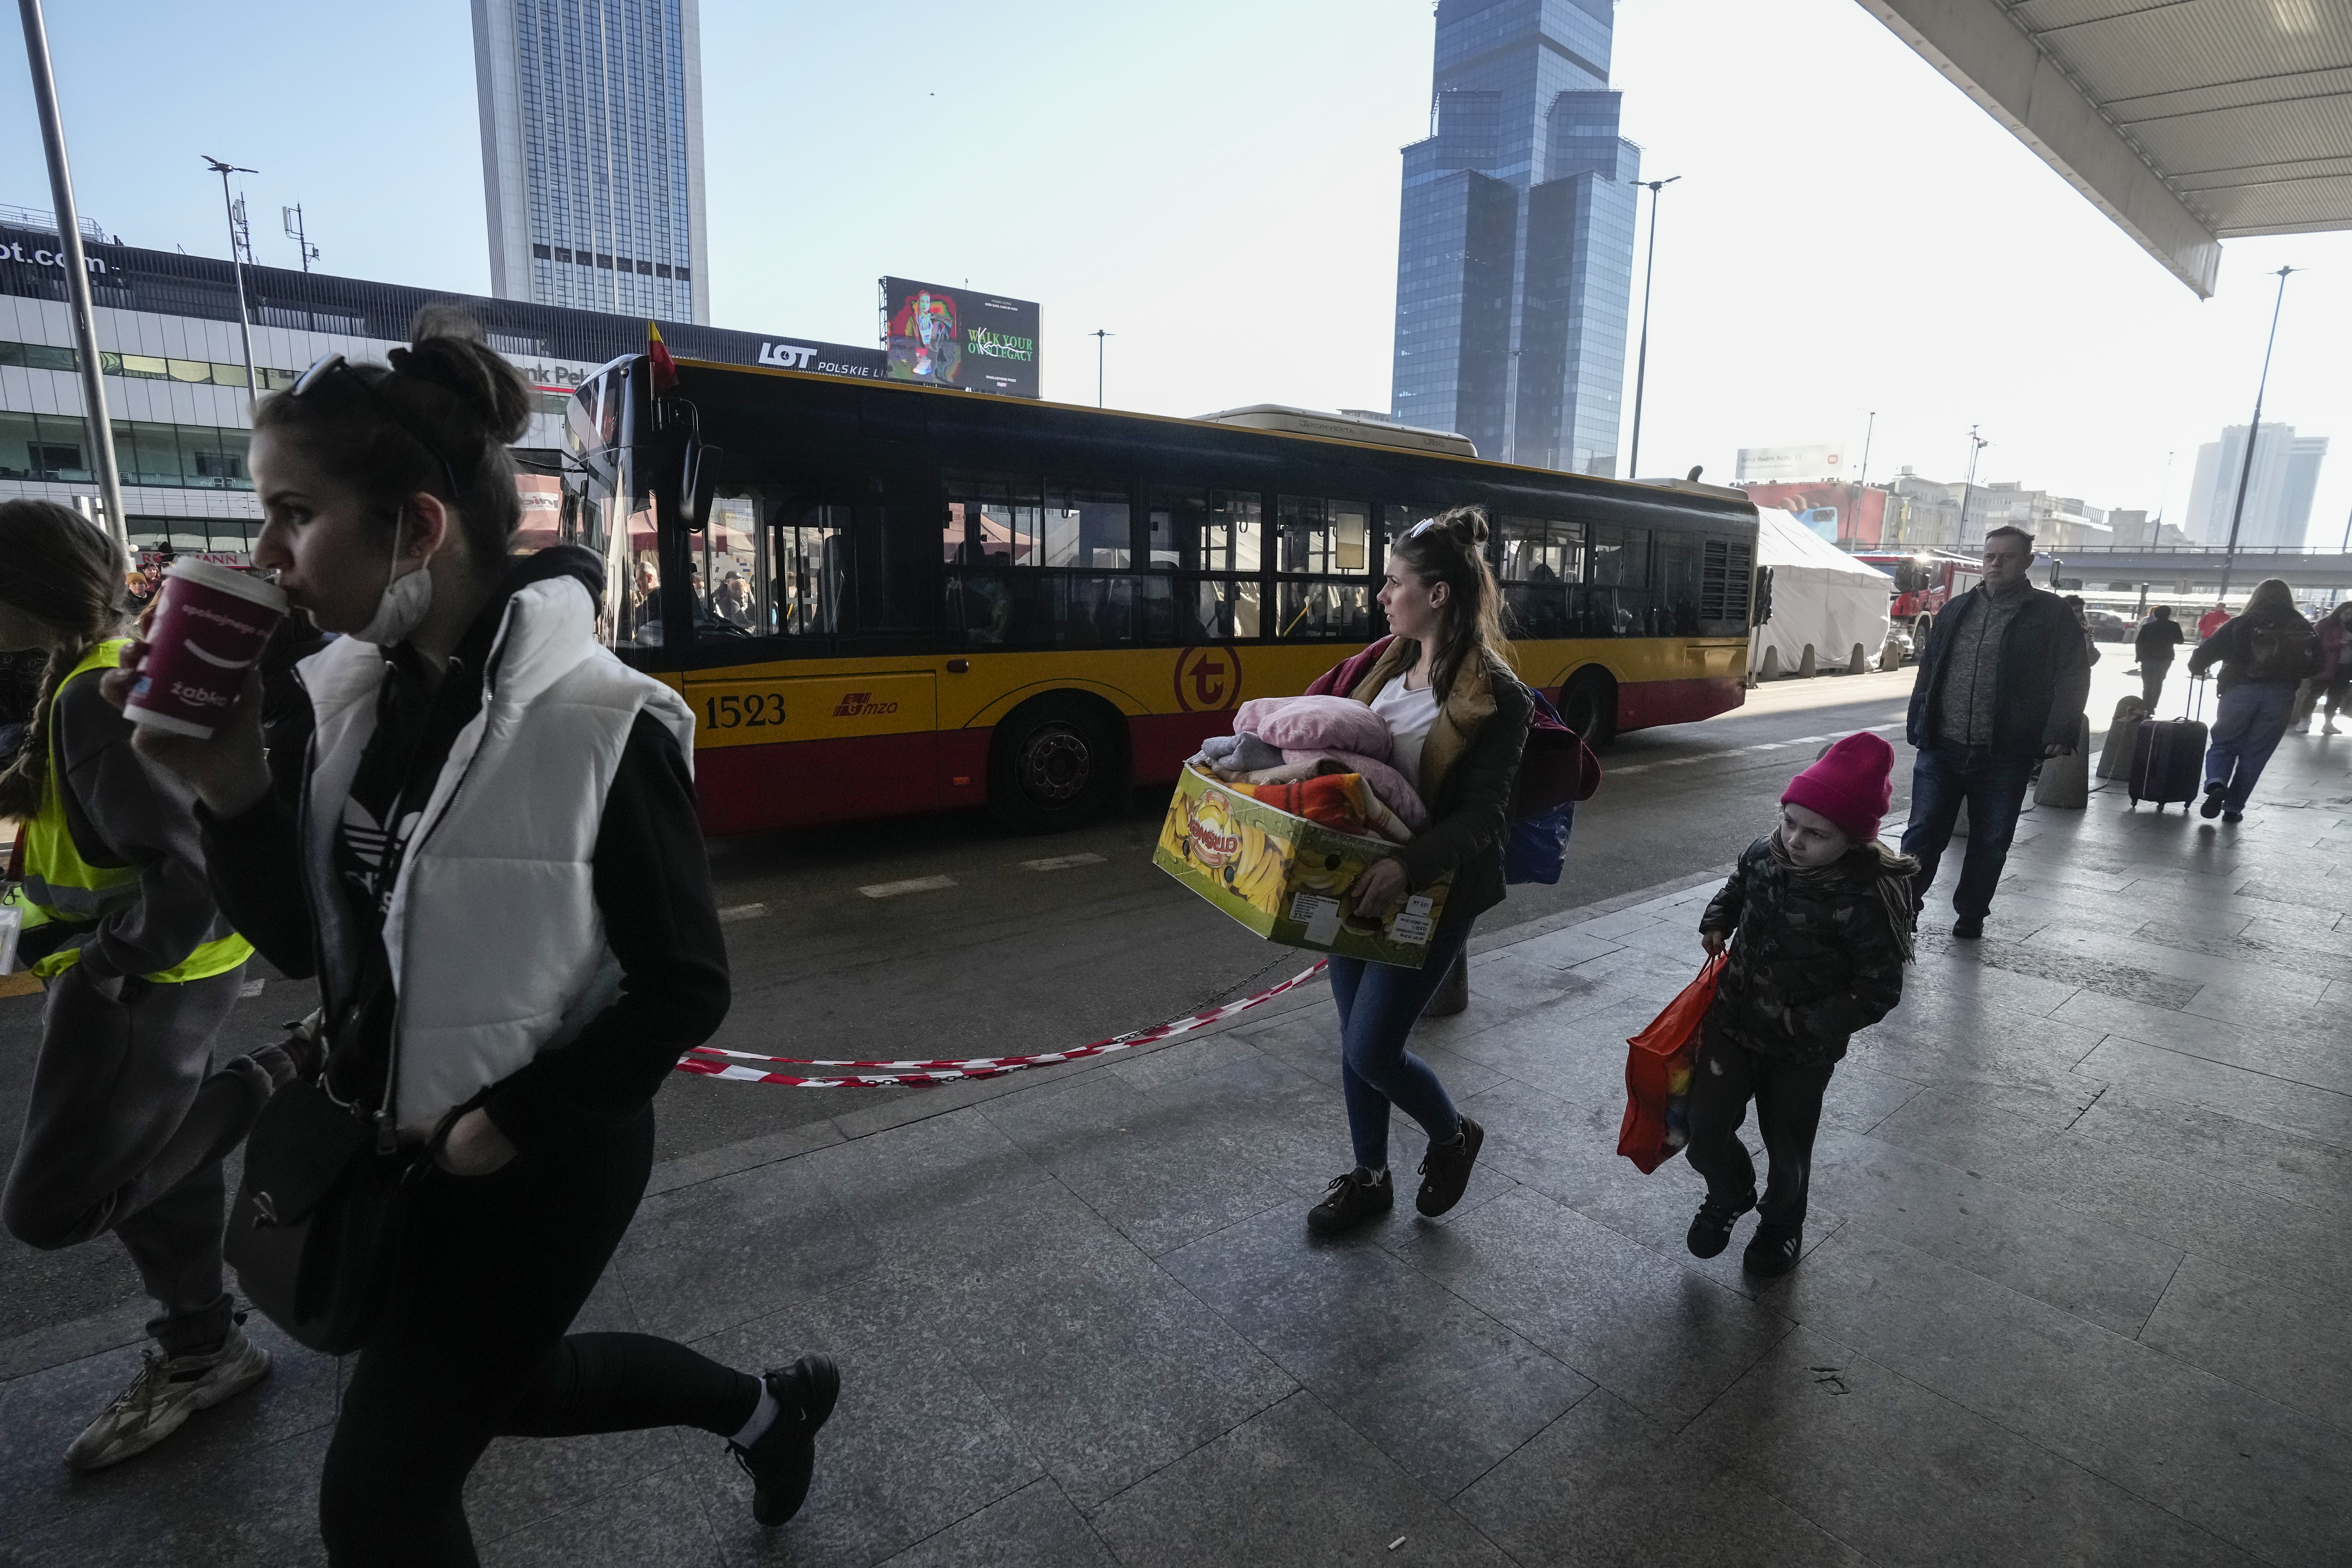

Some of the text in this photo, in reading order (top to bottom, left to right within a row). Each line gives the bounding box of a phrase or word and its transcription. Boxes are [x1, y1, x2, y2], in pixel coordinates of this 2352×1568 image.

[968, 329, 1033, 350] WALK YOUR
[968, 343, 1033, 361] OWN LEGACY
[758, 343, 818, 369] LOT
[818, 362, 869, 376] POLSKIE
[706, 693, 898, 729] 1523 mza
